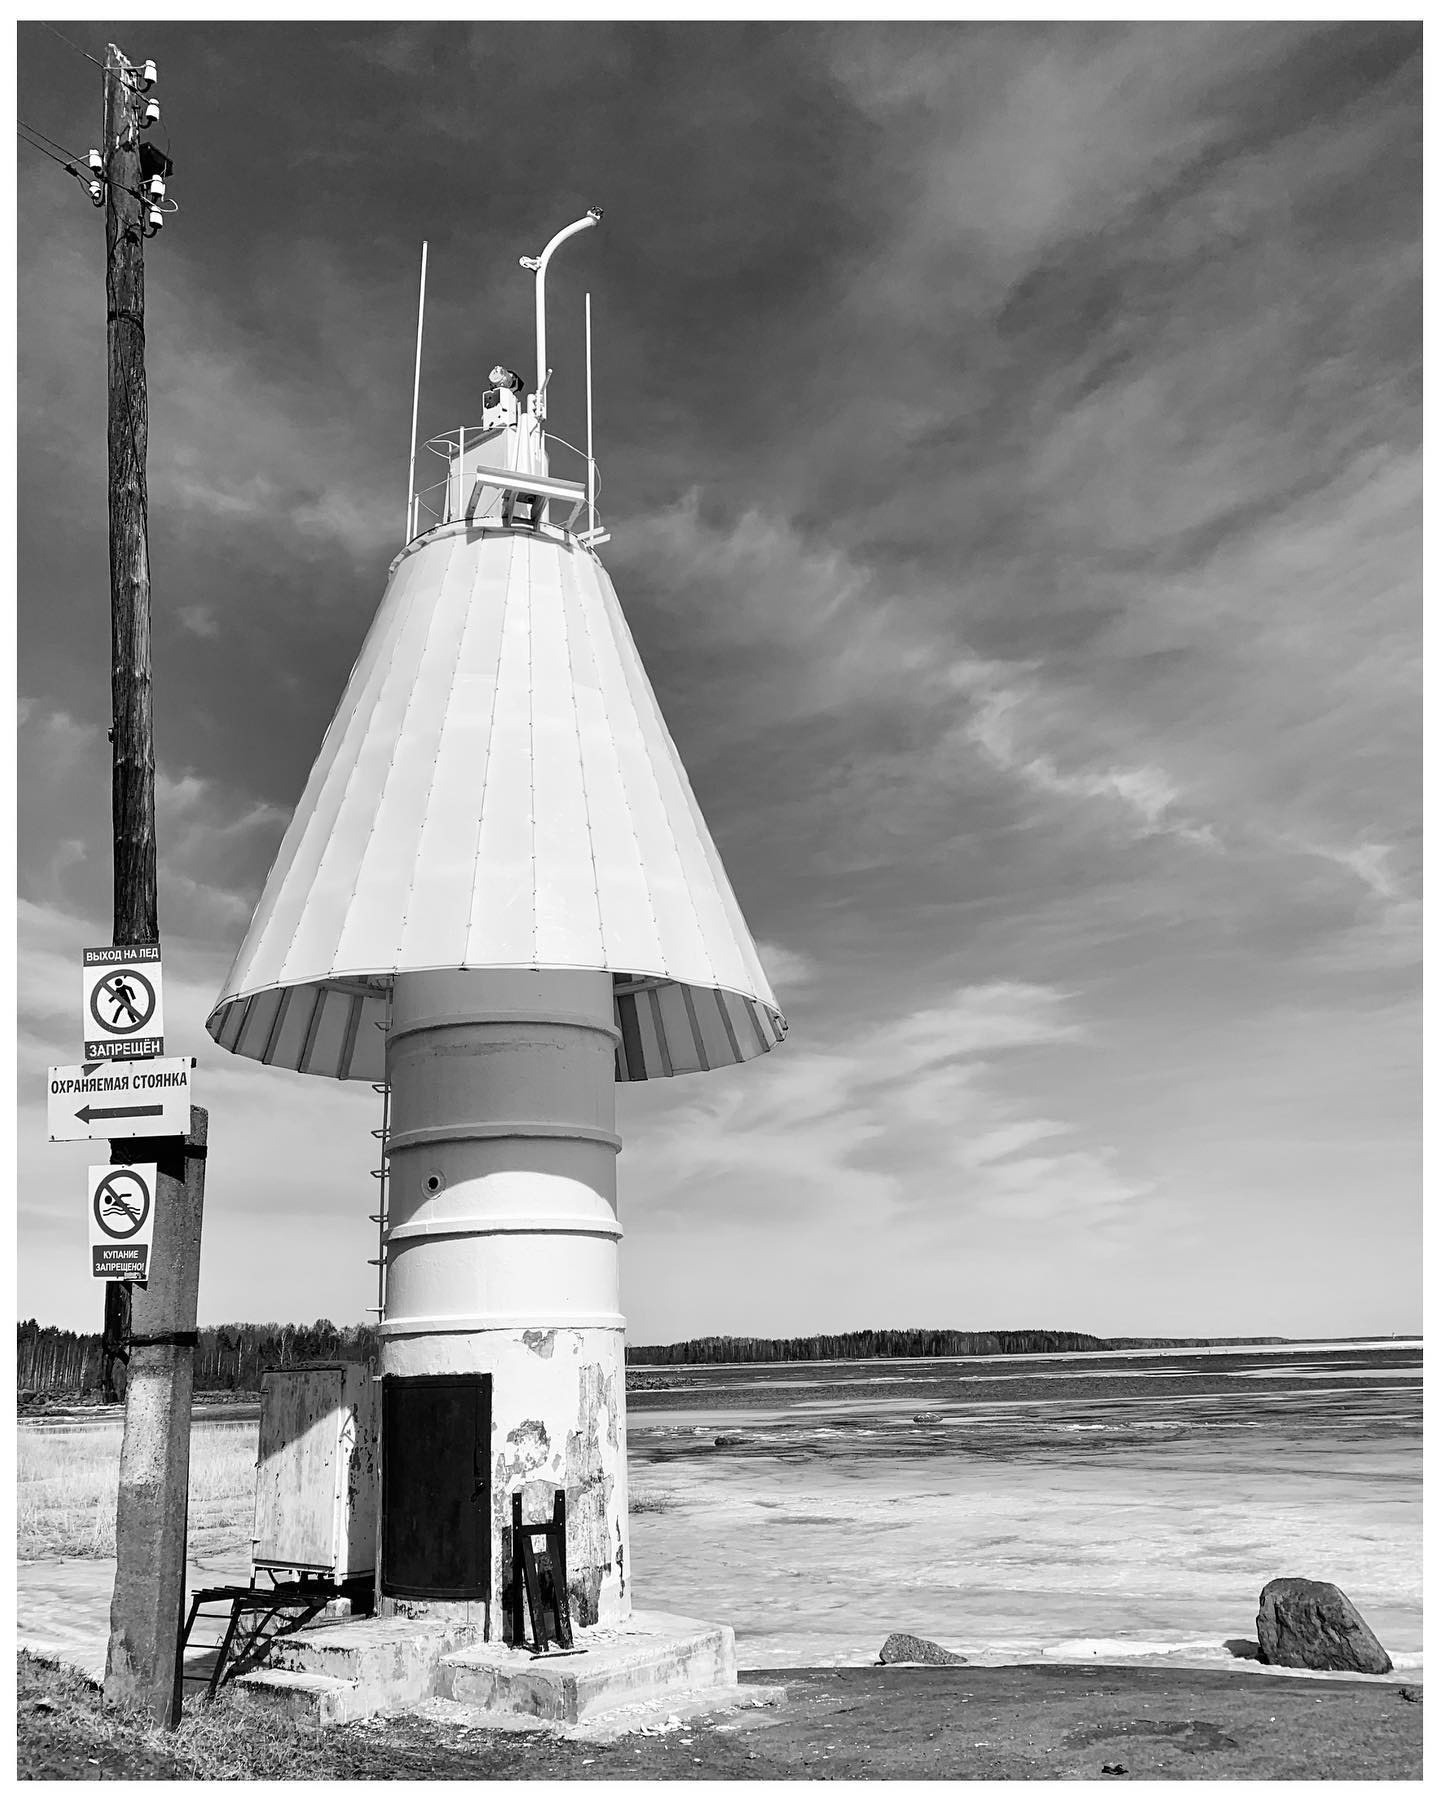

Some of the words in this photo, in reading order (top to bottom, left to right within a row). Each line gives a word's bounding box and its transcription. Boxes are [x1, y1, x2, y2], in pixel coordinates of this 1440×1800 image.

[86, 950, 122, 961] ВЫХОД
[124, 949, 137, 959] НА
[139, 947, 159, 959] ЛЕД
[89, 1038, 160, 1057] ЗАПРЕЩЁН
[51, 1076, 129, 1094] ОХРАНЯЕМАЯ
[133, 1072, 187, 1089] СТОЯНКА
[103, 1250, 139, 1259] КУПАНИЕ
[95, 1262, 145, 1272] ЗАПРЕЩЕНО!
